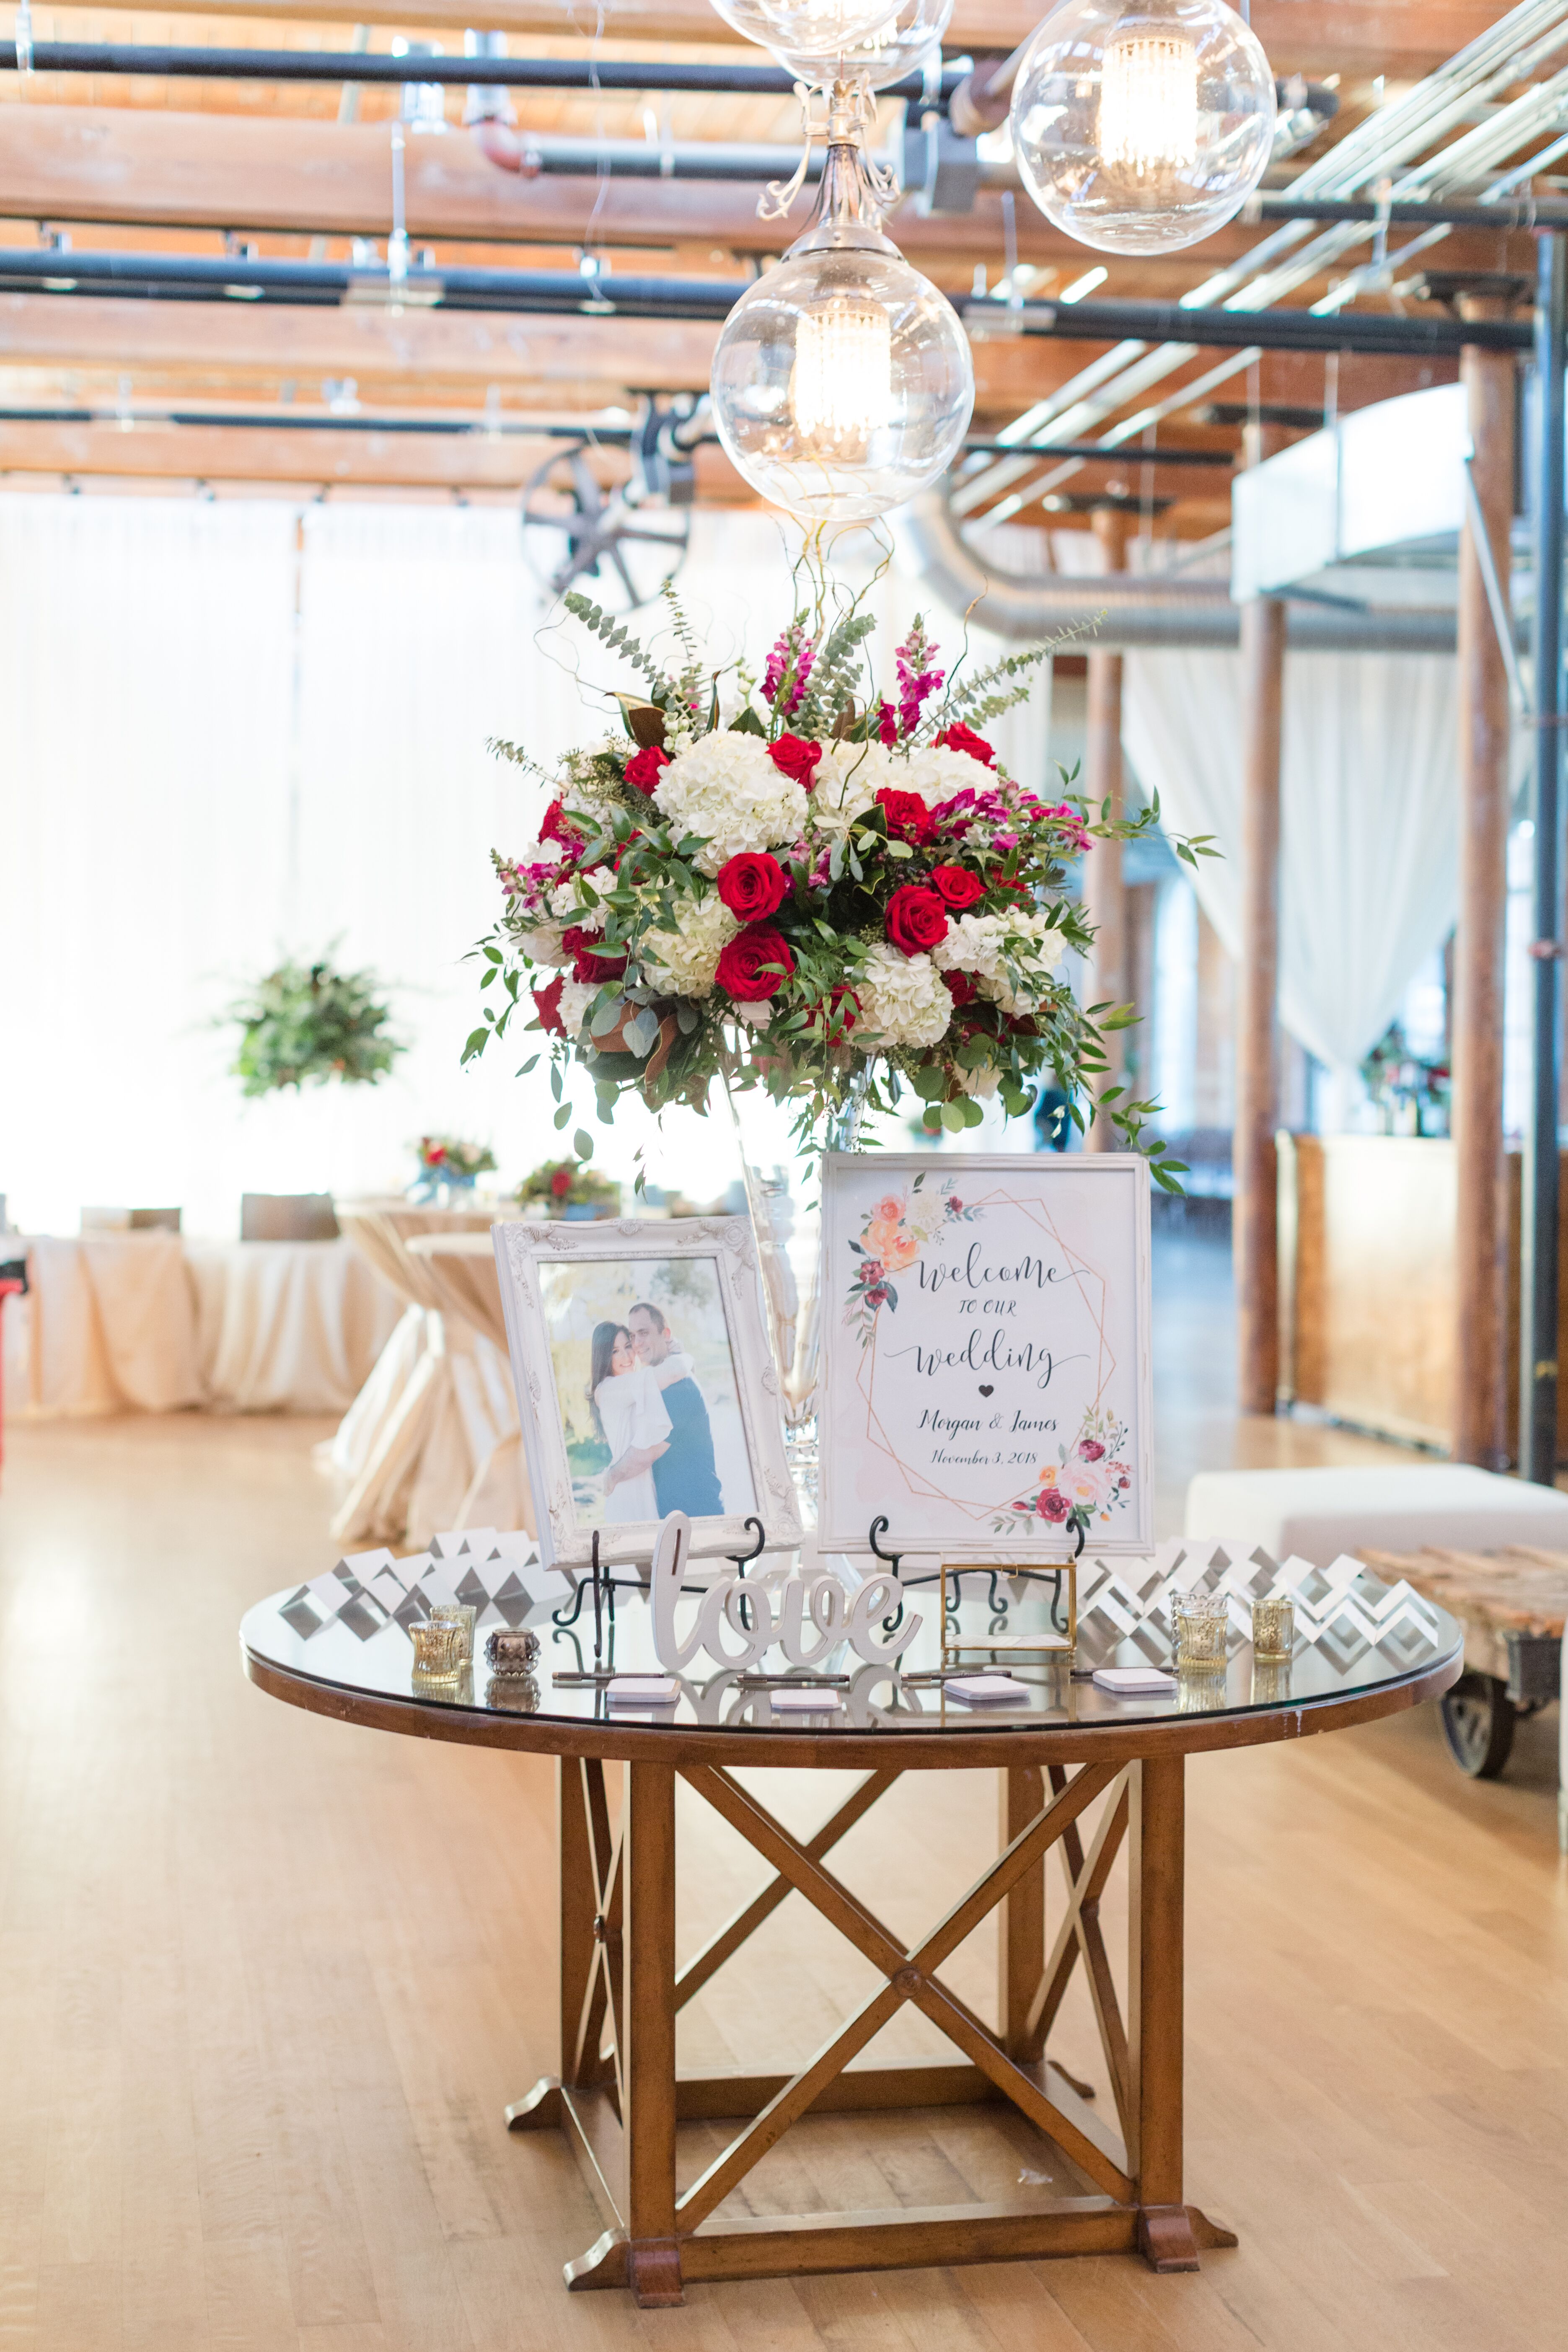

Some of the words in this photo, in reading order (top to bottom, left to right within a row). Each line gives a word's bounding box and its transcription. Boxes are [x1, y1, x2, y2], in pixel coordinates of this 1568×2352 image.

[884, 1242, 1090, 1292] welcome
[958, 1299, 977, 1314] TO
[983, 1299, 1017, 1316] OUR
[883, 1329, 1091, 1389] wedding
[916, 1409, 983, 1441] Morgan
[988, 1413, 1004, 1429] &
[1009, 1410, 1059, 1433] James
[929, 1448, 989, 1465] November
[1007, 1452, 1038, 1464] 2018
[650, 1509, 923, 1671] love
